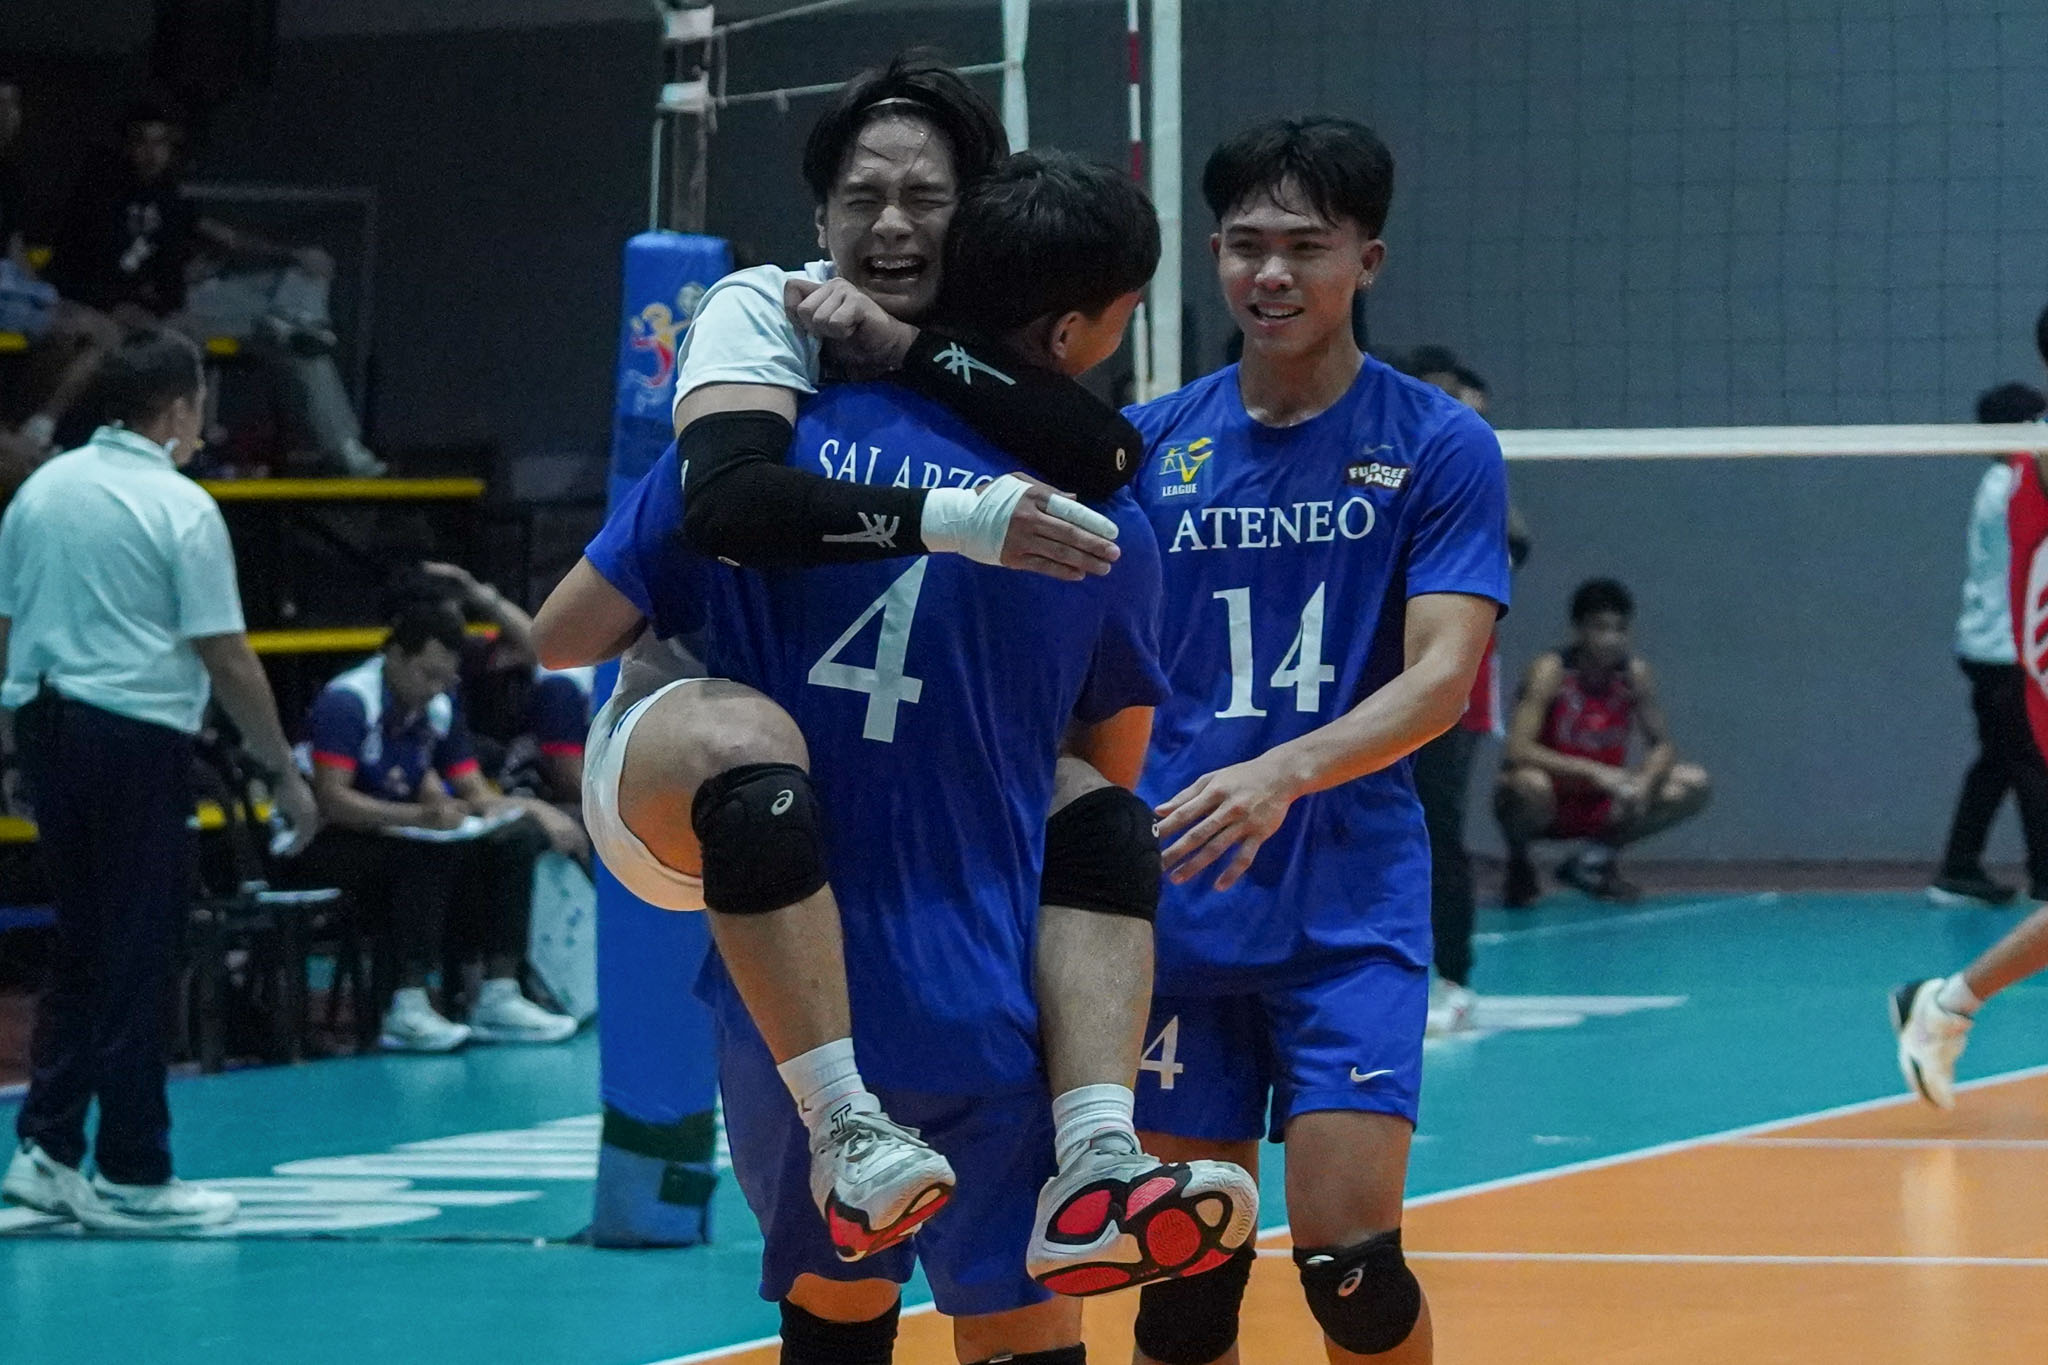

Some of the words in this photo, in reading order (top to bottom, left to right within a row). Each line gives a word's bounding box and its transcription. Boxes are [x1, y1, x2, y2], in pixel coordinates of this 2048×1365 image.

[1162, 483, 1198, 497] LEAGUE
[1348, 462, 1408, 479] FUDGEE
[1168, 496, 1376, 553] ATENEO
[807, 555, 929, 743] 4
[1213, 581, 1335, 718] 14
[1138, 1014, 1183, 1090] 4
